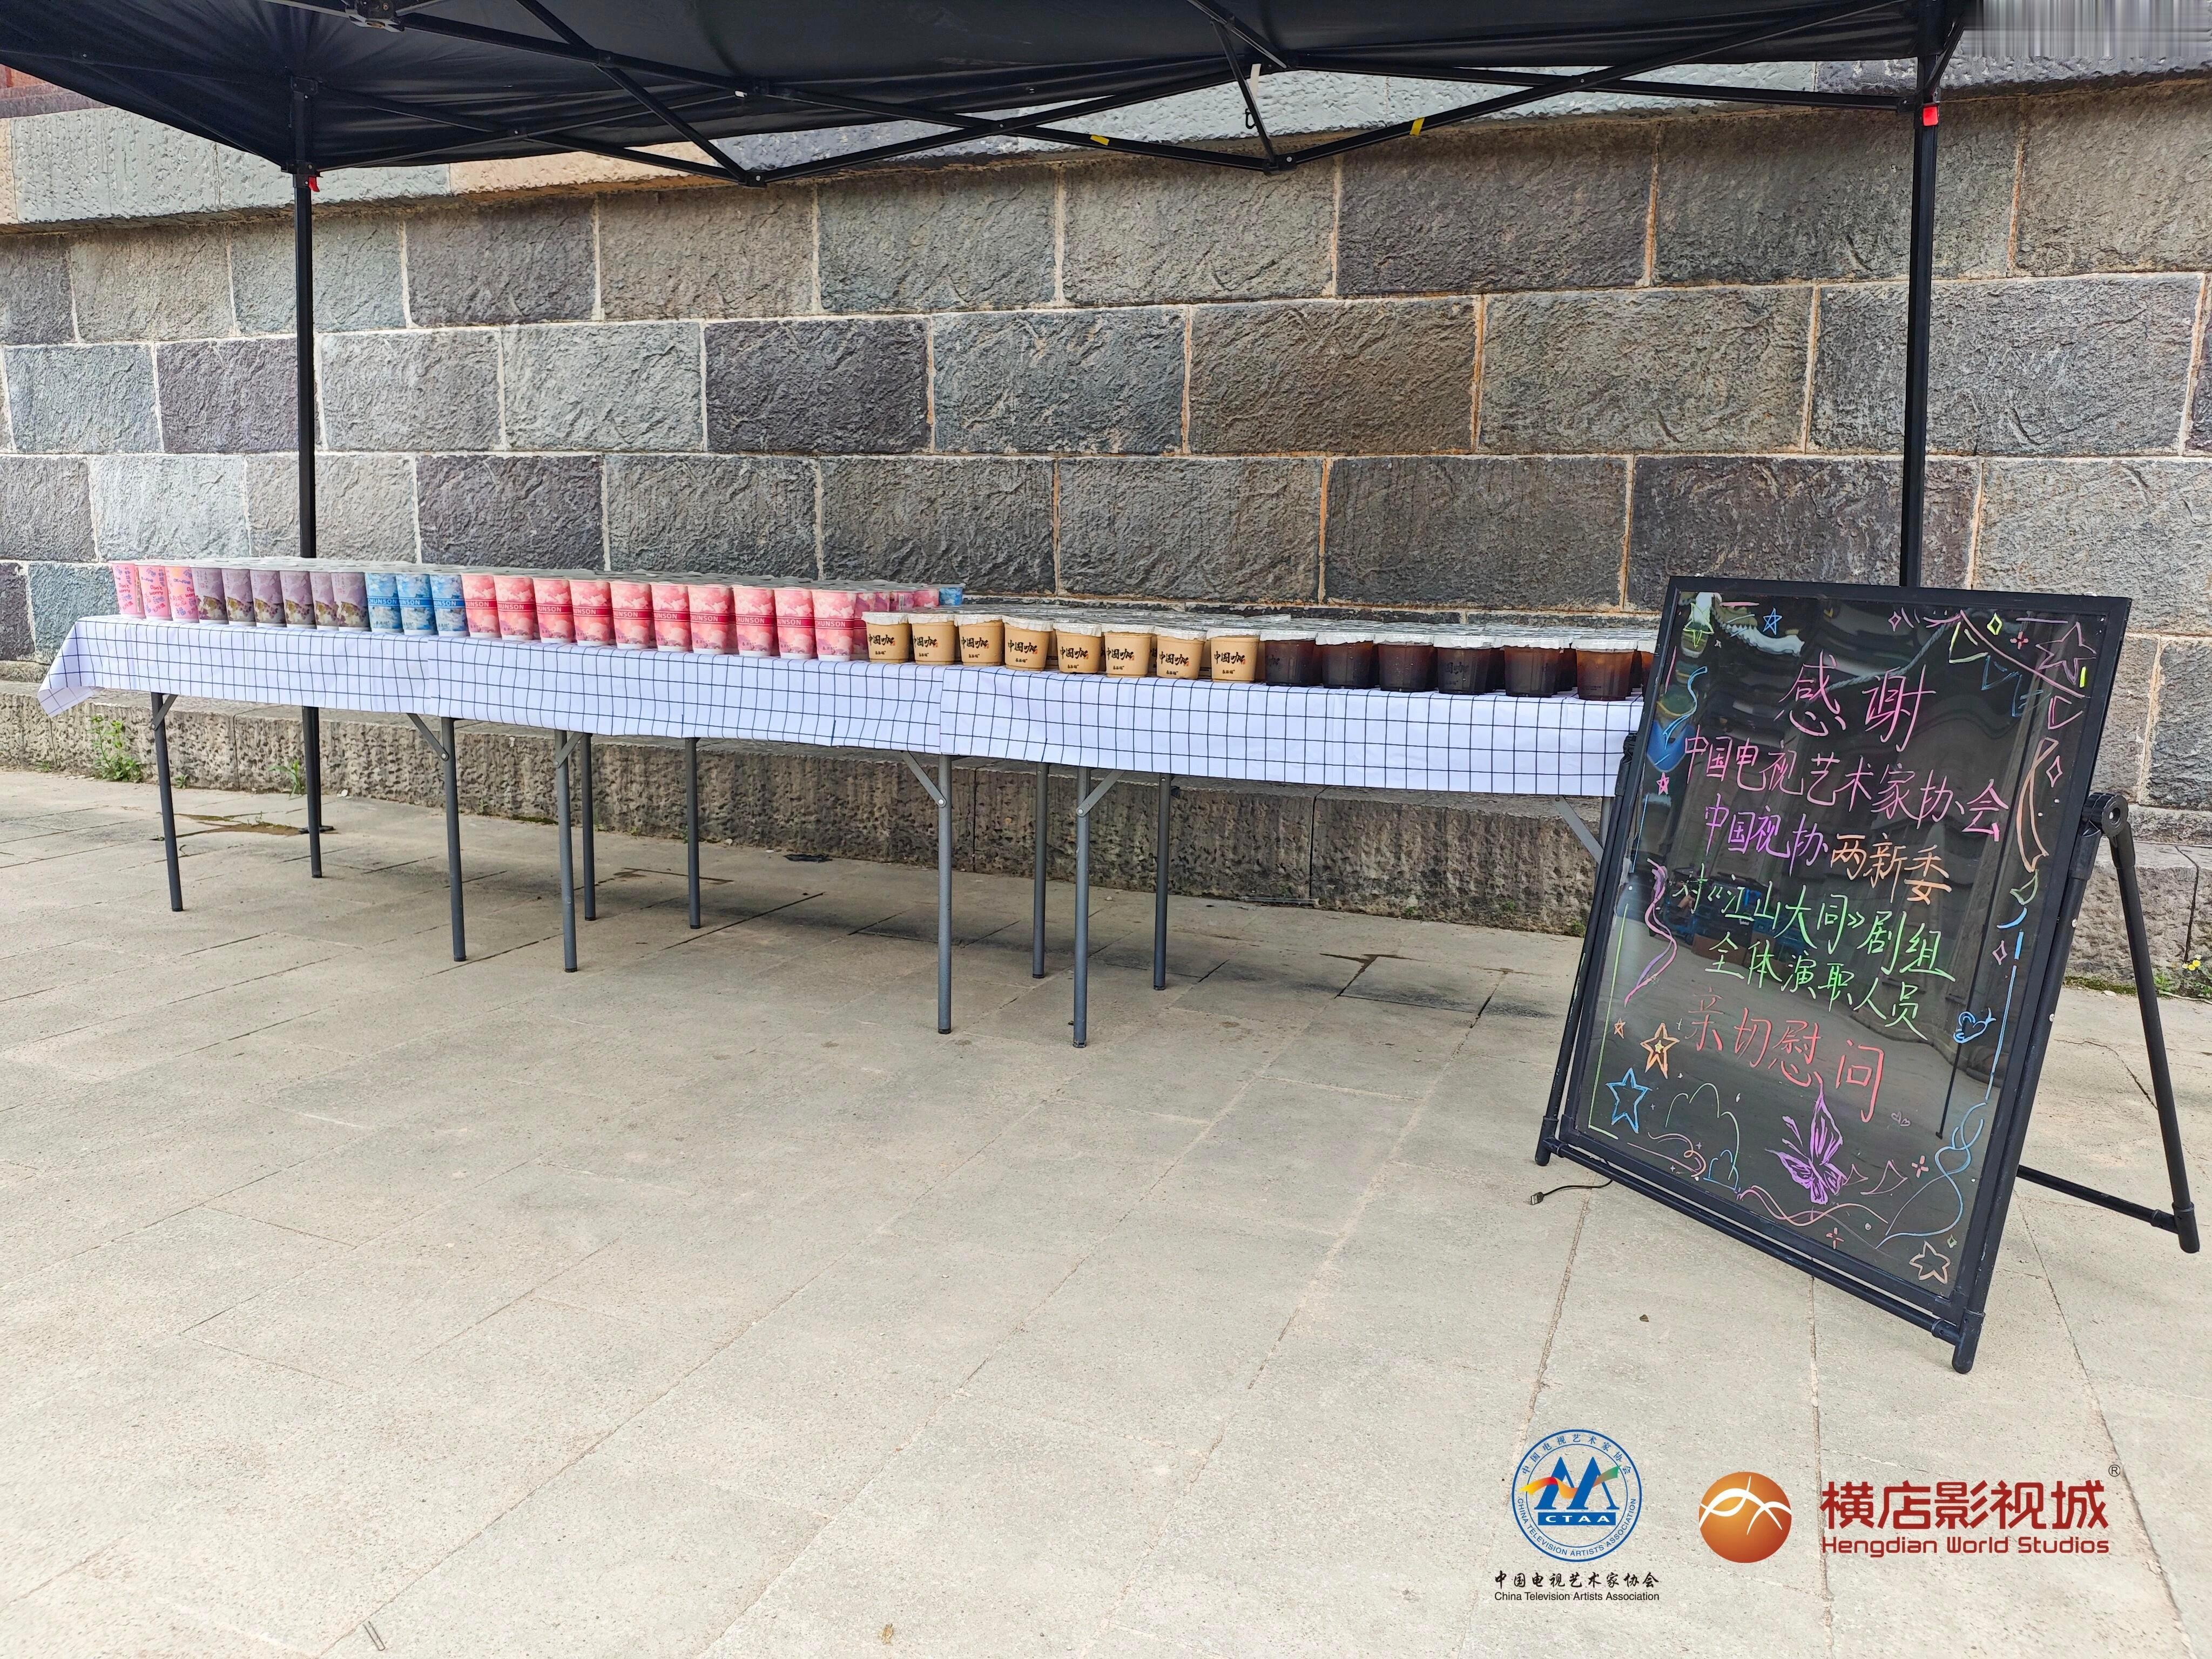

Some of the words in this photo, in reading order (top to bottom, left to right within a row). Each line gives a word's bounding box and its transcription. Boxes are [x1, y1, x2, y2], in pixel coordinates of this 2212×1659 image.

[1773, 649, 1937, 752] 感谢
[1684, 724, 2009, 841] 中国电视艺术家协会
[1705, 793, 1952, 905] 中国视协两新委
[1673, 864, 1957, 982] 对《江山大同》剧组
[1705, 932, 1928, 1040] 全体演职人员
[1685, 988, 1884, 1123] 亲切慰问
